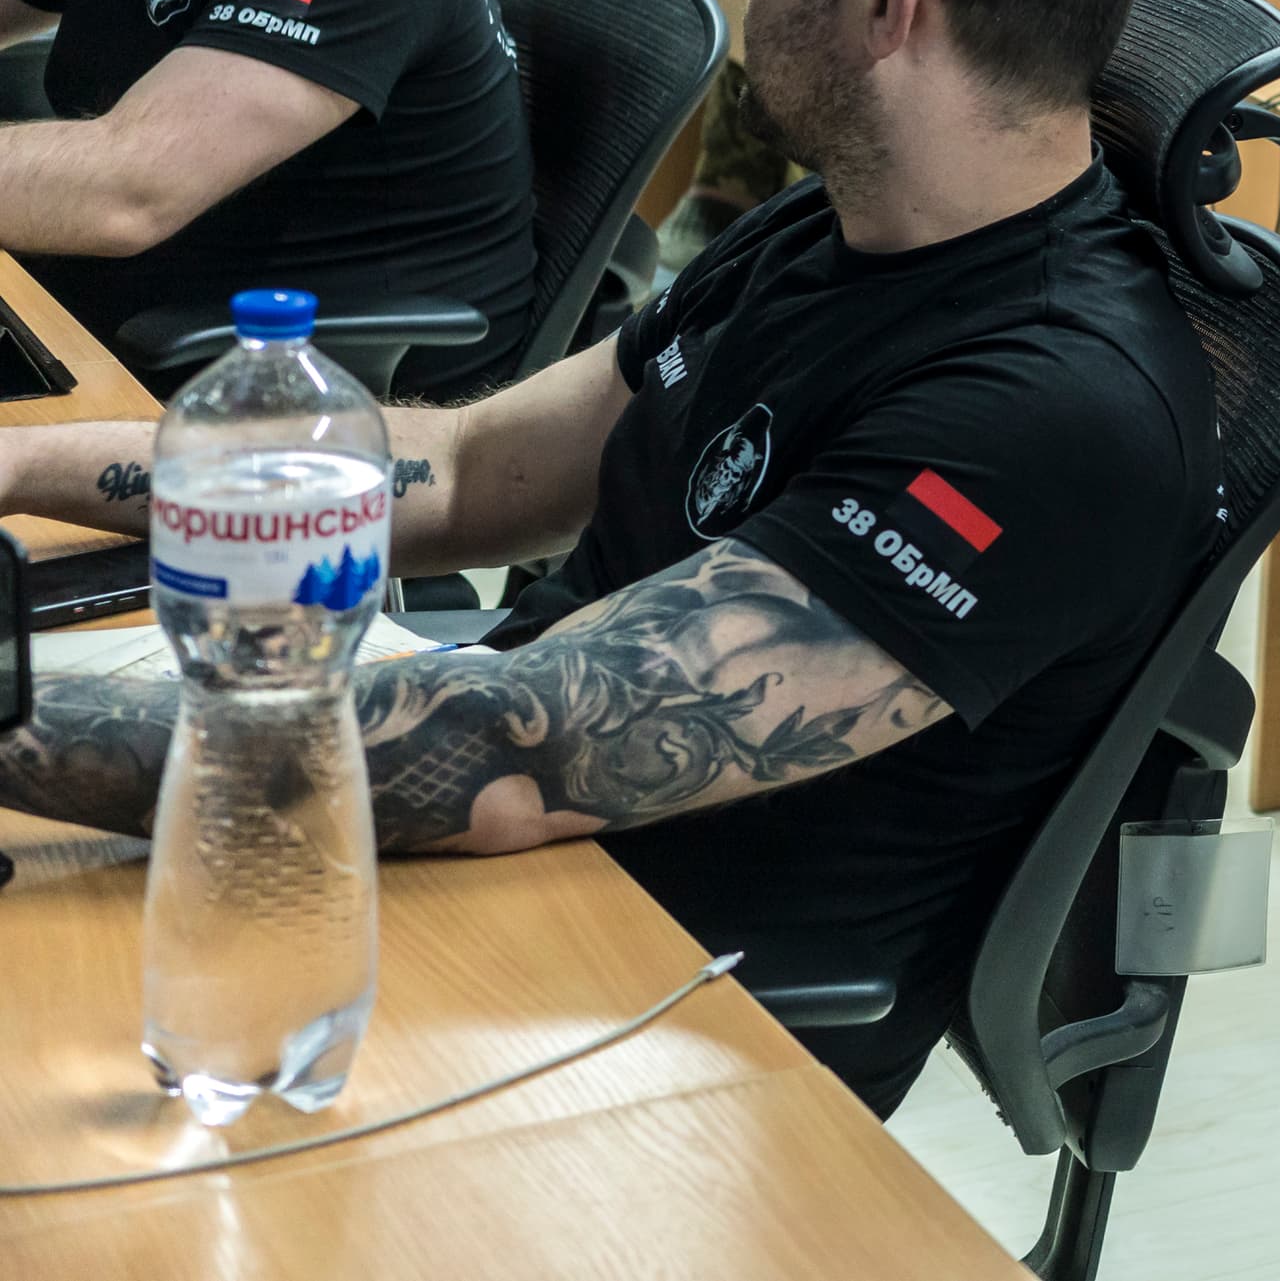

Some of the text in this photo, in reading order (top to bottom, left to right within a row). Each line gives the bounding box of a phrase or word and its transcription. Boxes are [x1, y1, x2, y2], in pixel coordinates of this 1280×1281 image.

[208, 4, 321, 45] 38 ОБрМП
[830, 498, 979, 620] 38 ОБрМП
